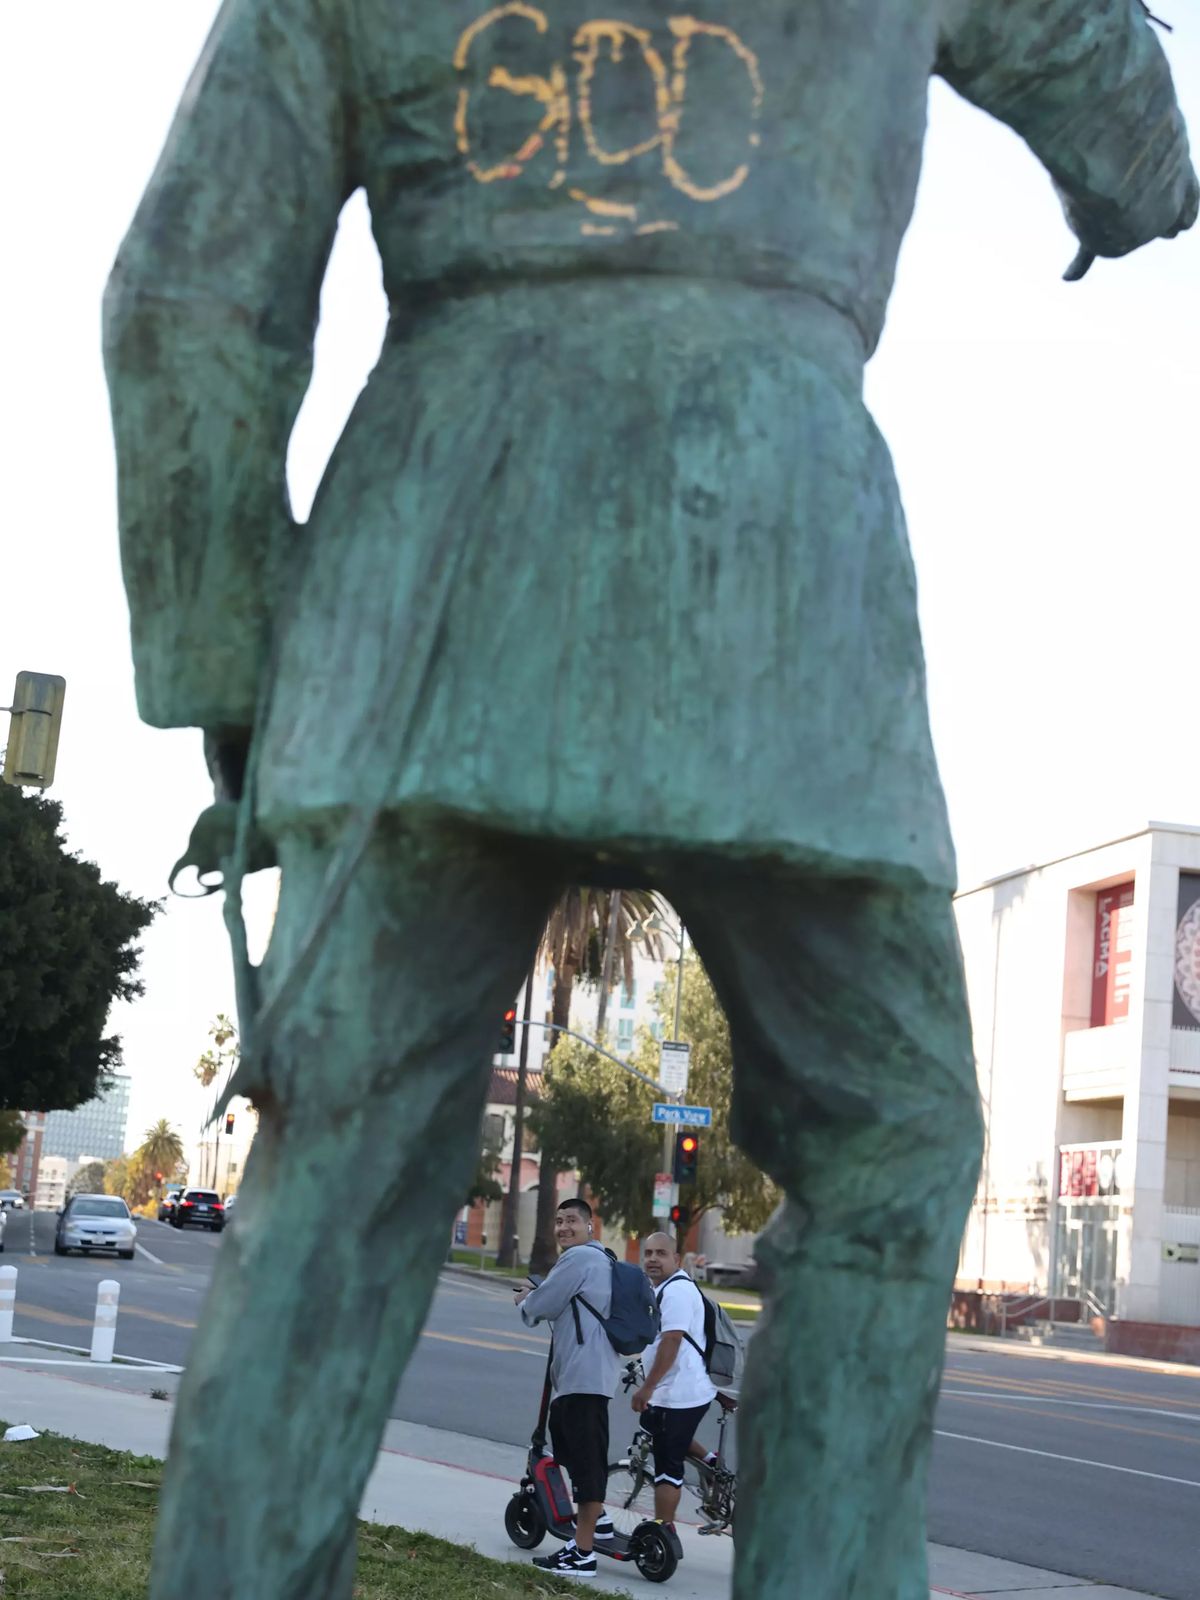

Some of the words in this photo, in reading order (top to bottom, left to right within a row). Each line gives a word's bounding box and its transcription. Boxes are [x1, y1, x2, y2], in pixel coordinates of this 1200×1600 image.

[1095, 896, 1112, 978] LACMA
[657, 1107, 681, 1121] Park
[683, 1110, 706, 1123] View
